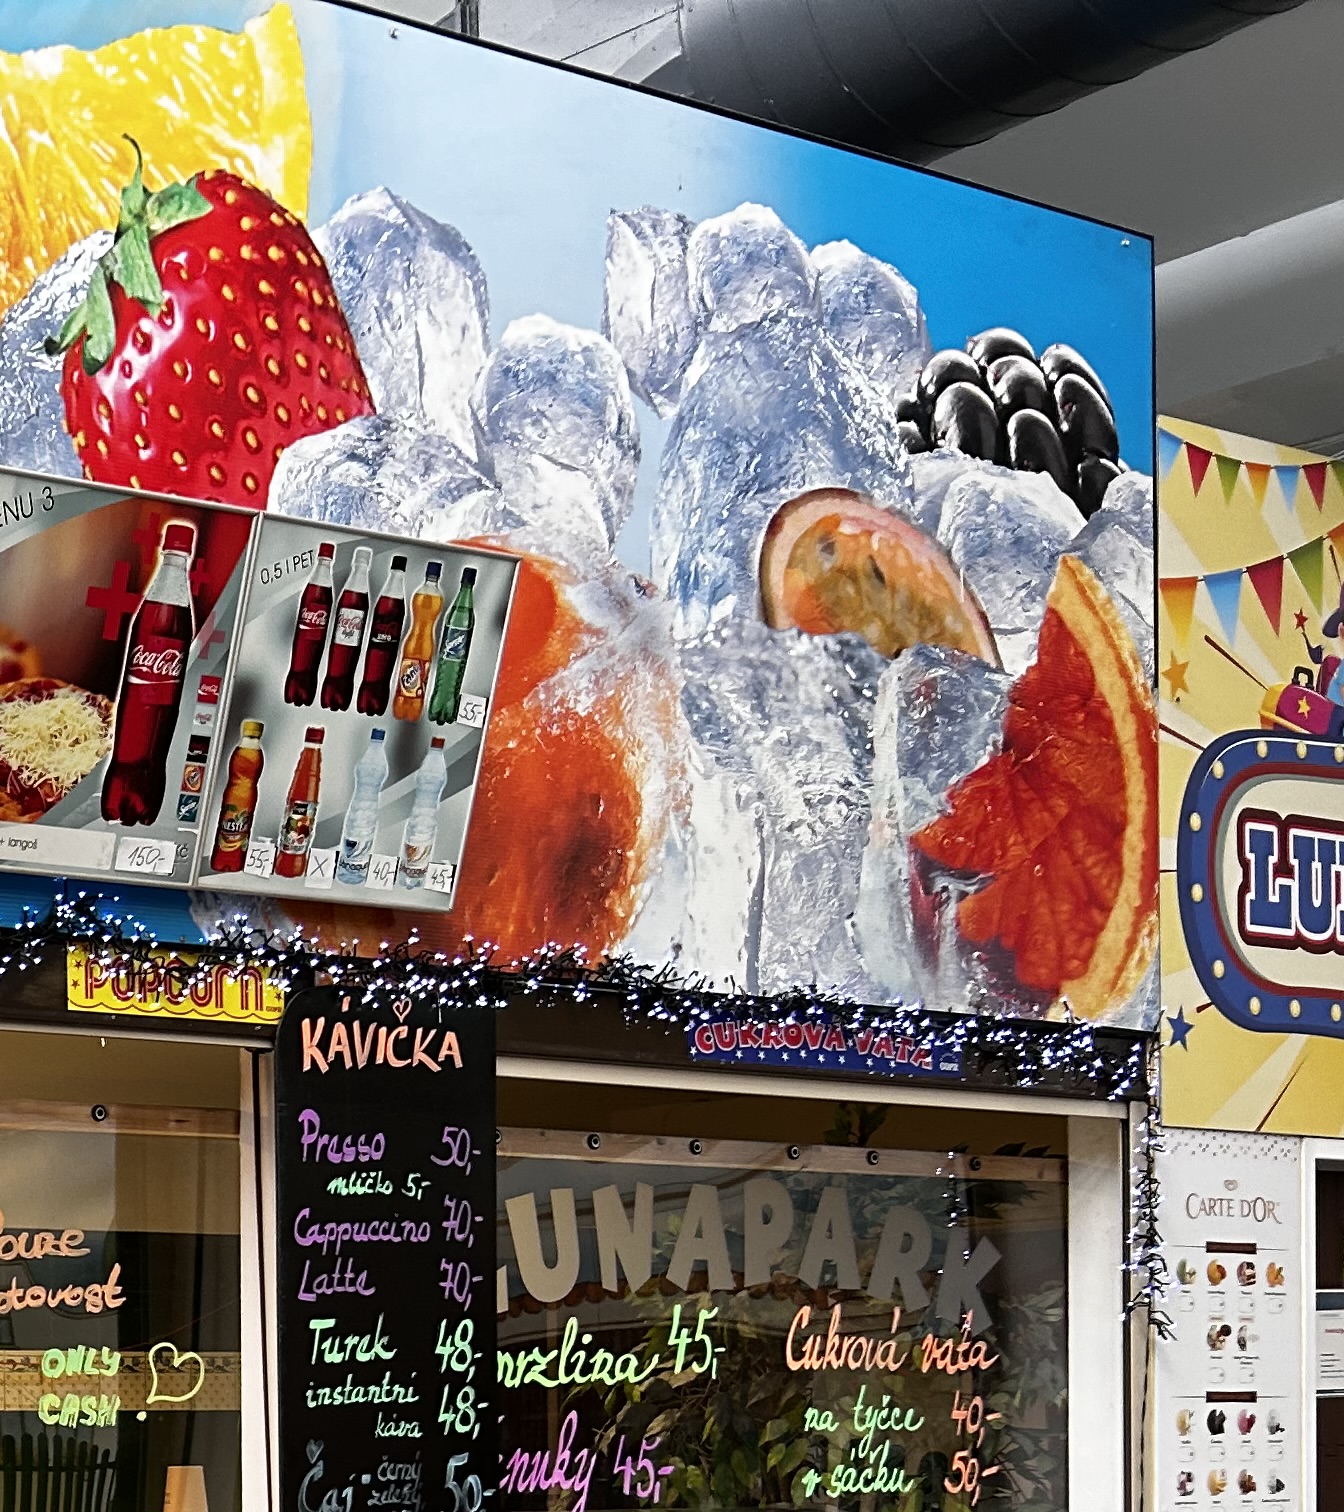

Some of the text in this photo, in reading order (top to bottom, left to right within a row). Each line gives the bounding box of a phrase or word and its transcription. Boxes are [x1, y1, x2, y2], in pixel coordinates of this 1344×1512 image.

[40, 488, 55, 512] 3
[260, 549, 314, 585] 0,5 PET
[7, 837, 38, 850] langoš
[302, 996, 463, 1074] KÁVIČKA
[298, 1109, 385, 1163] Presso
[1185, 1192, 1235, 1219] CARTE
[294, 1208, 431, 1255] Cappuccino
[298, 1257, 376, 1301] Latte
[497, 1182, 1001, 1333] UNAPARK
[309, 1312, 397, 1364] Turek
[786, 1303, 1000, 1375] Cukrová vata
